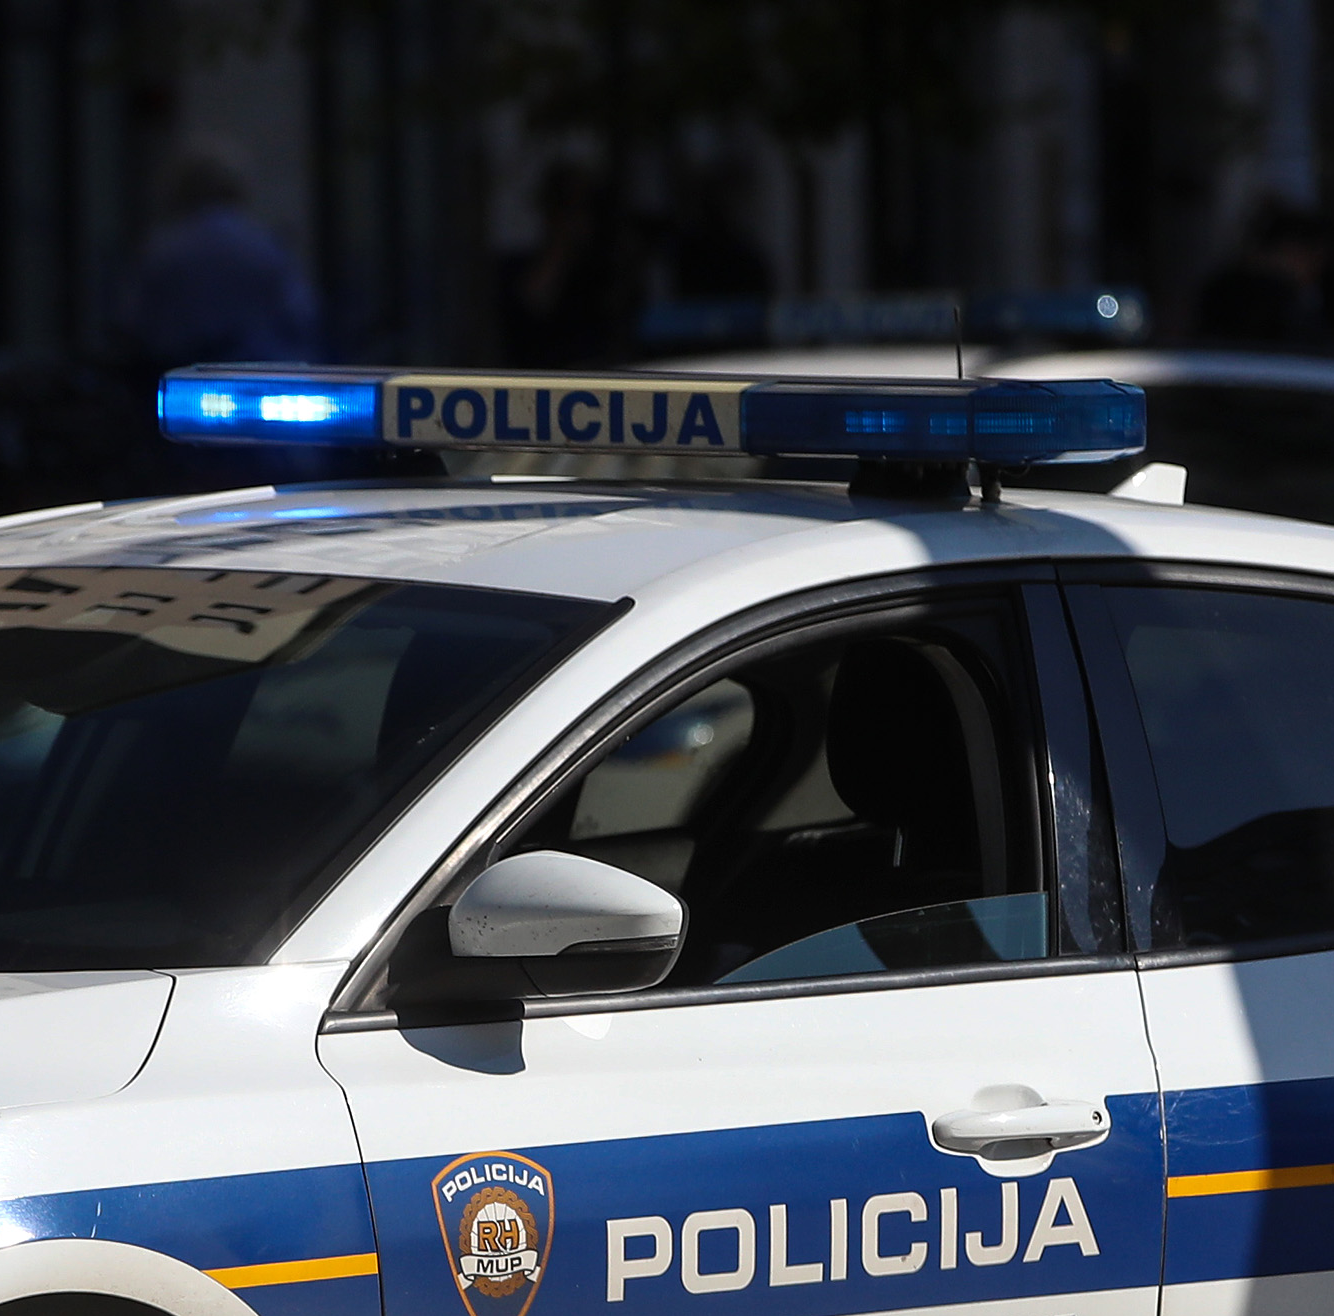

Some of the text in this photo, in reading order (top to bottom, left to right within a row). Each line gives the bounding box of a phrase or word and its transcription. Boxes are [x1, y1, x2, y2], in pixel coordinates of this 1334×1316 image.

[397, 387, 725, 446] POLICIJA
[441, 1163, 545, 1203] POLICIJA
[476, 1218, 520, 1252] RH
[607, 1177, 1100, 1302] POLICIJA
[476, 1256, 522, 1274] MUP
